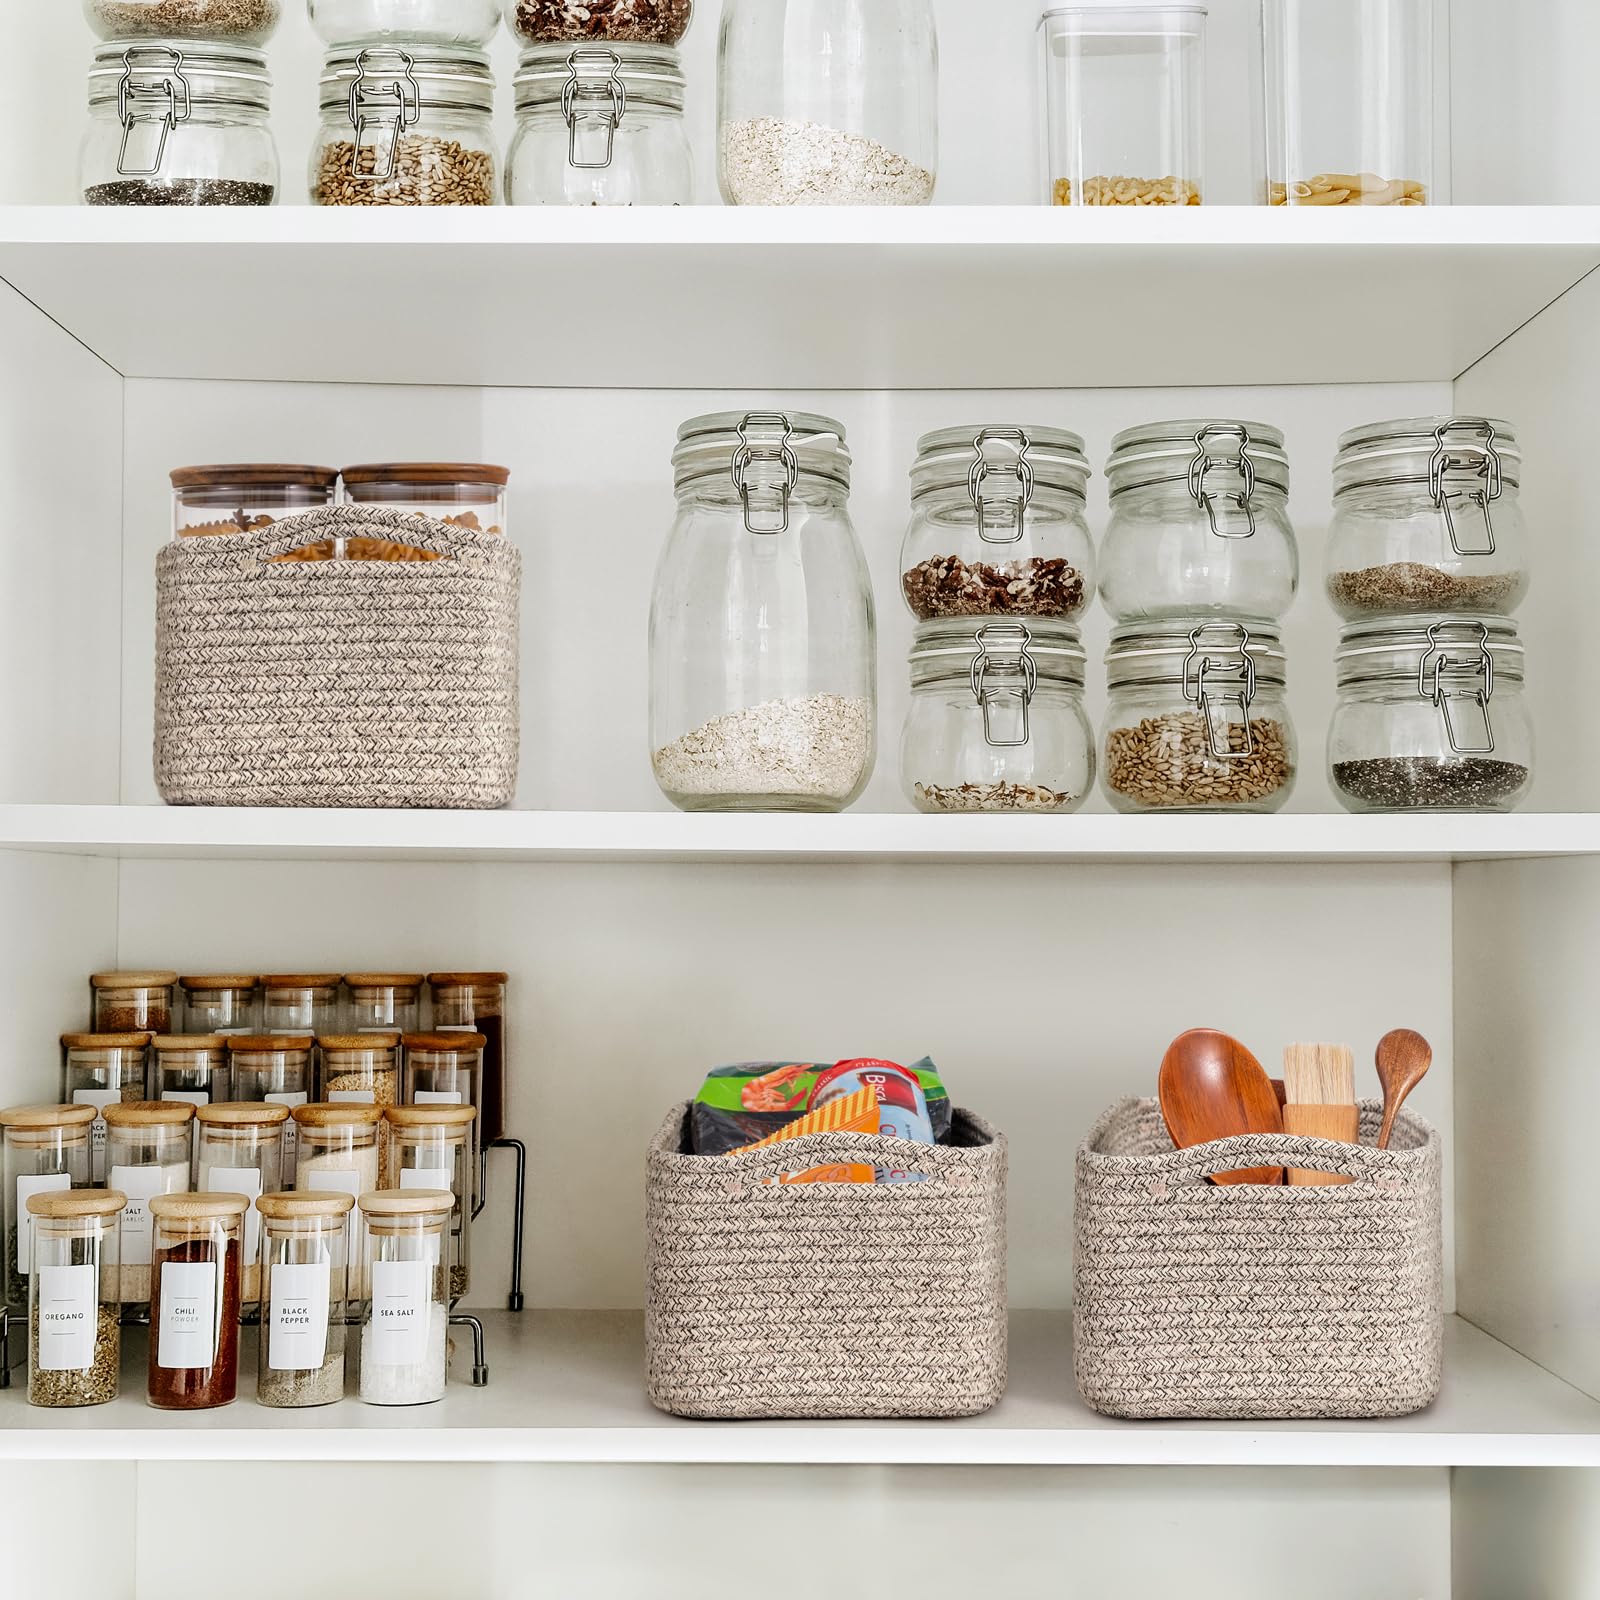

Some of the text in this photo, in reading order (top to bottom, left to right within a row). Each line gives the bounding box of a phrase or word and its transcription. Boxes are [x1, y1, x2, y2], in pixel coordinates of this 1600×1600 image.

[175, 1307, 195, 1315] CHILI
[283, 1307, 308, 1315] BLACK
[380, 1307, 414, 1317] SEA SALT
[45, 1312, 84, 1321] OREGANO
[281, 1316, 310, 1324] PEPPER
